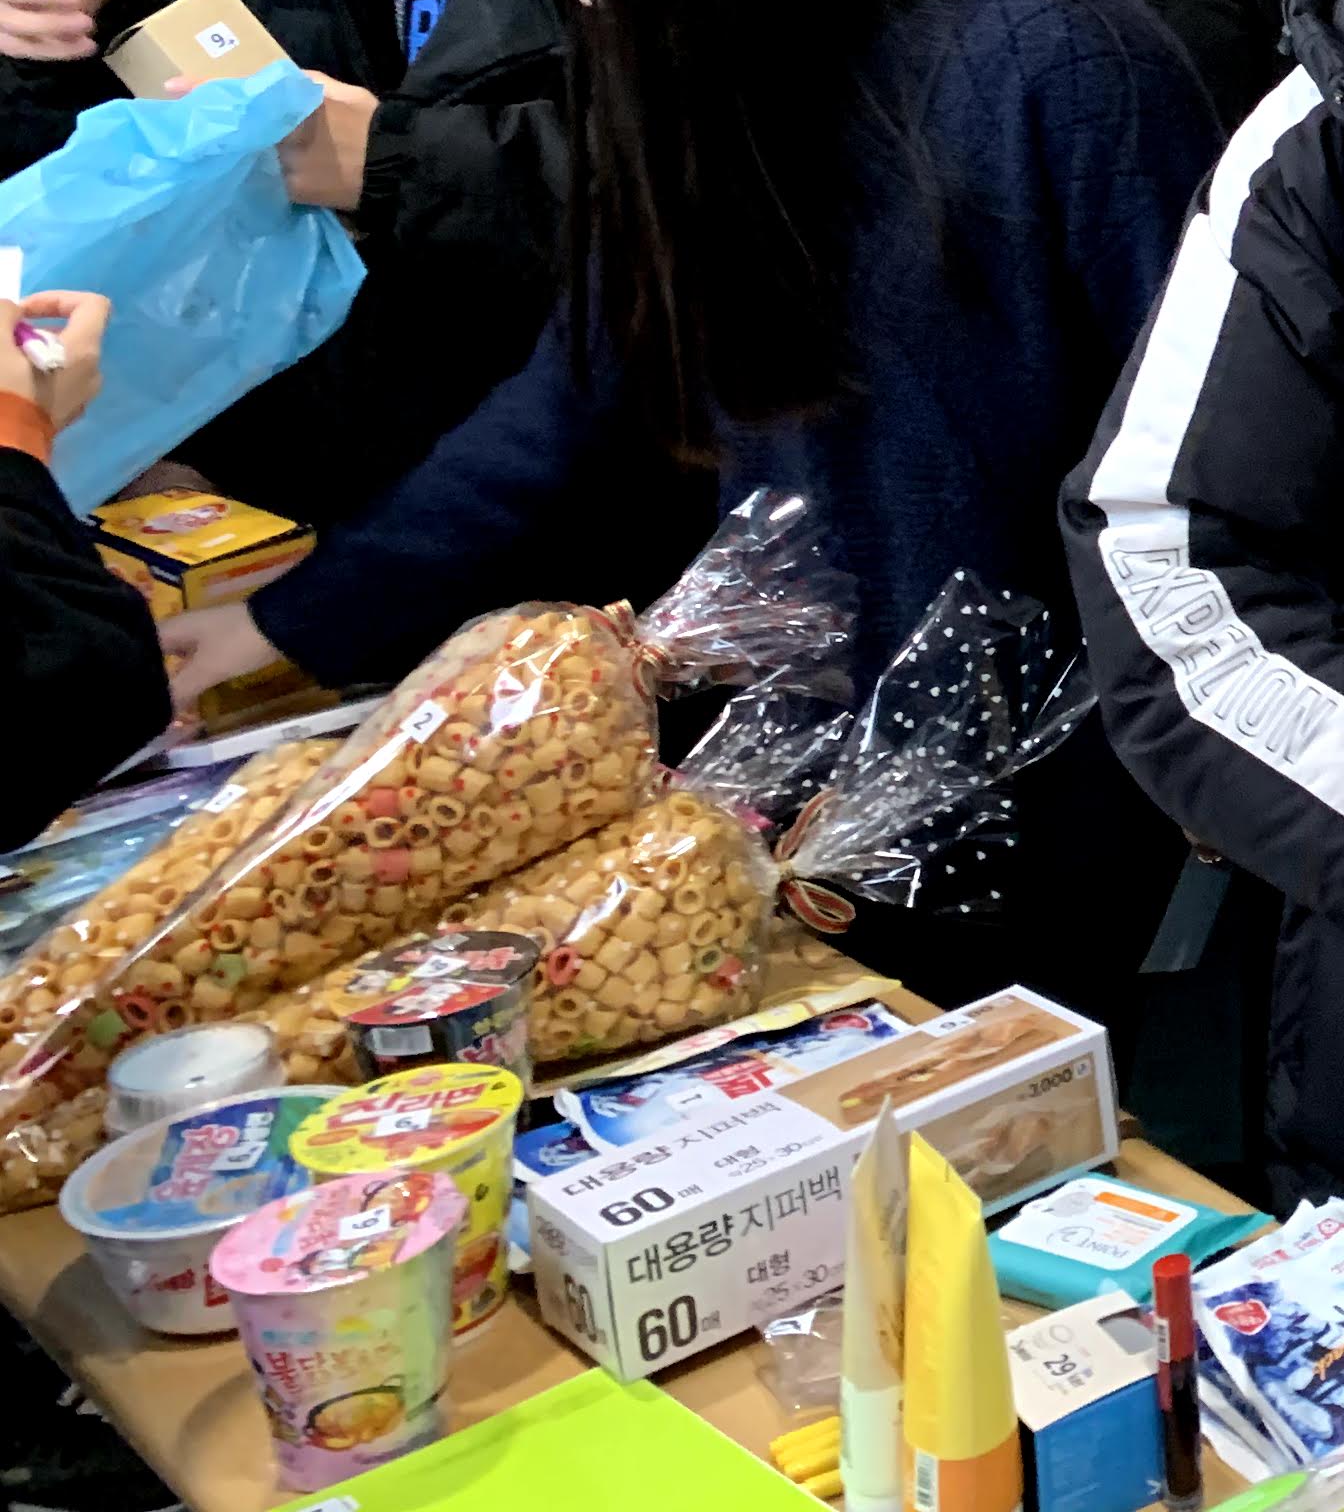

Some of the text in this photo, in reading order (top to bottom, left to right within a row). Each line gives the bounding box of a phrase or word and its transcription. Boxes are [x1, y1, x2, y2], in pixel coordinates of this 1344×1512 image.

[412, 711, 433, 732] 2
[562, 1101, 782, 1196] 대용량 지퍼백
[626, 1213, 735, 1284] 대용량
[740, 1165, 843, 1238] 지퍼백
[746, 1249, 791, 1285] 대형
